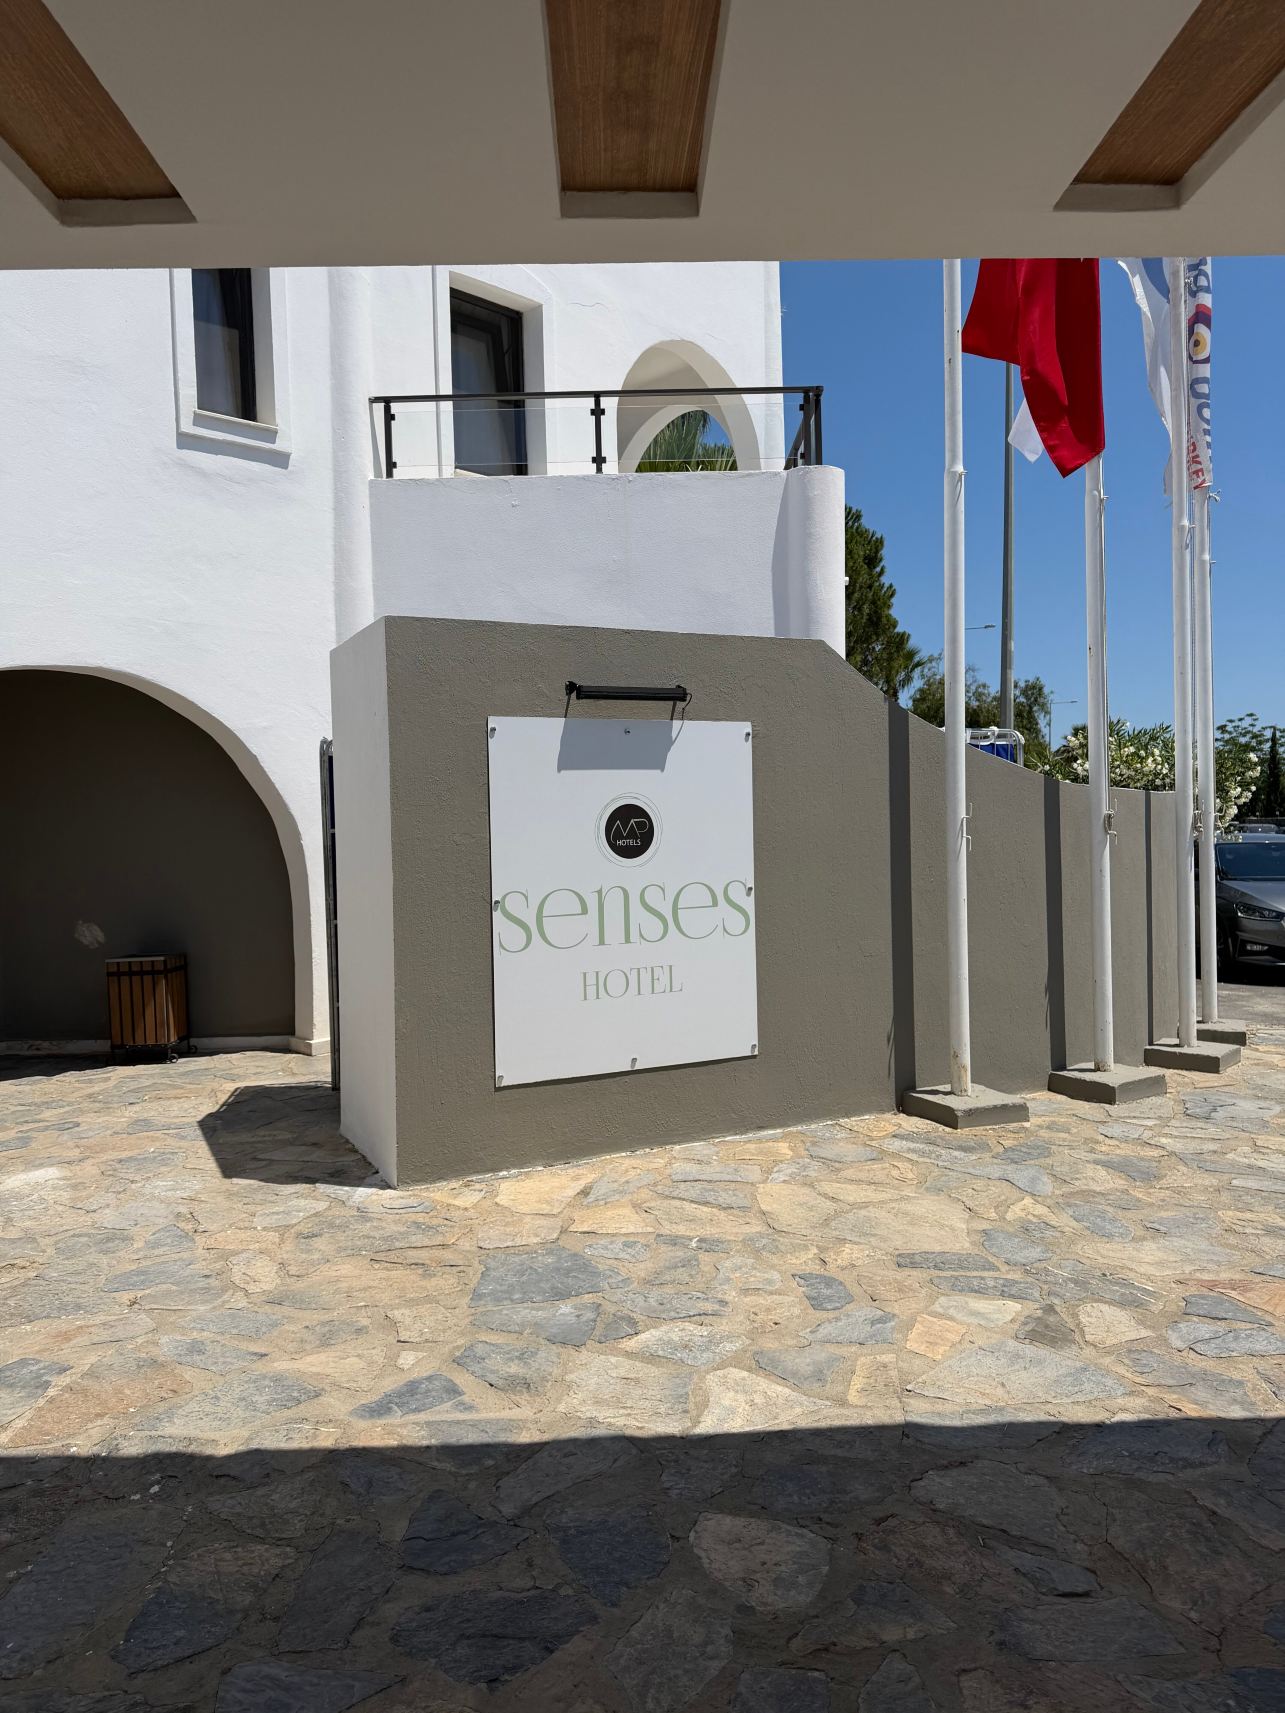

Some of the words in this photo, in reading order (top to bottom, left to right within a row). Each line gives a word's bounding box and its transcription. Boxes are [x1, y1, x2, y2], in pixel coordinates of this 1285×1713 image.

[616, 838, 641, 846] HOTELS
[498, 877, 751, 956] senses
[580, 964, 683, 1001] HOTEL
